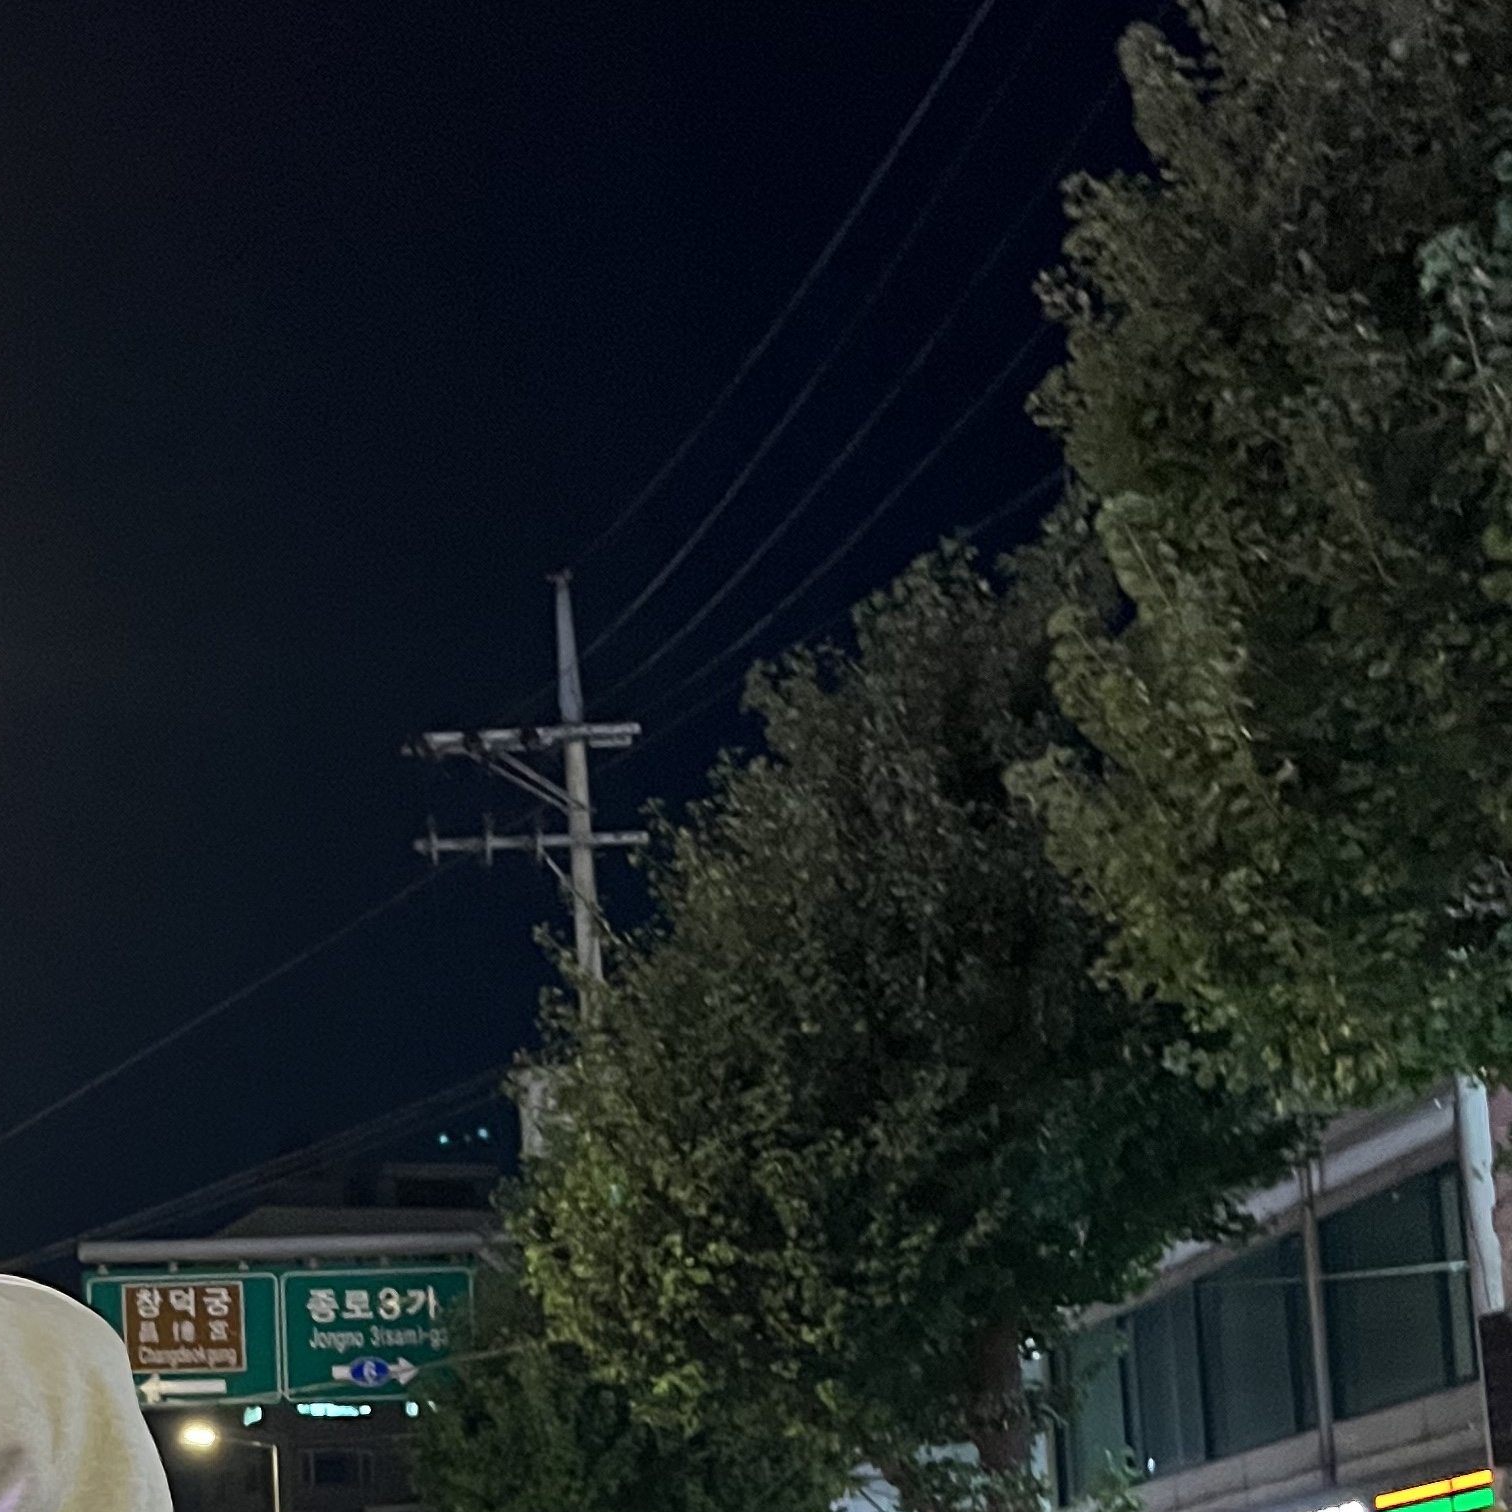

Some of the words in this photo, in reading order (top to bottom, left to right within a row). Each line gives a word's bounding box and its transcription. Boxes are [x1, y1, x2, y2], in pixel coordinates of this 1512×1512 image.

[135, 1286, 233, 1319] 창덕궁
[306, 1285, 439, 1323] 종로3가
[309, 1326, 365, 1353] Jongno
